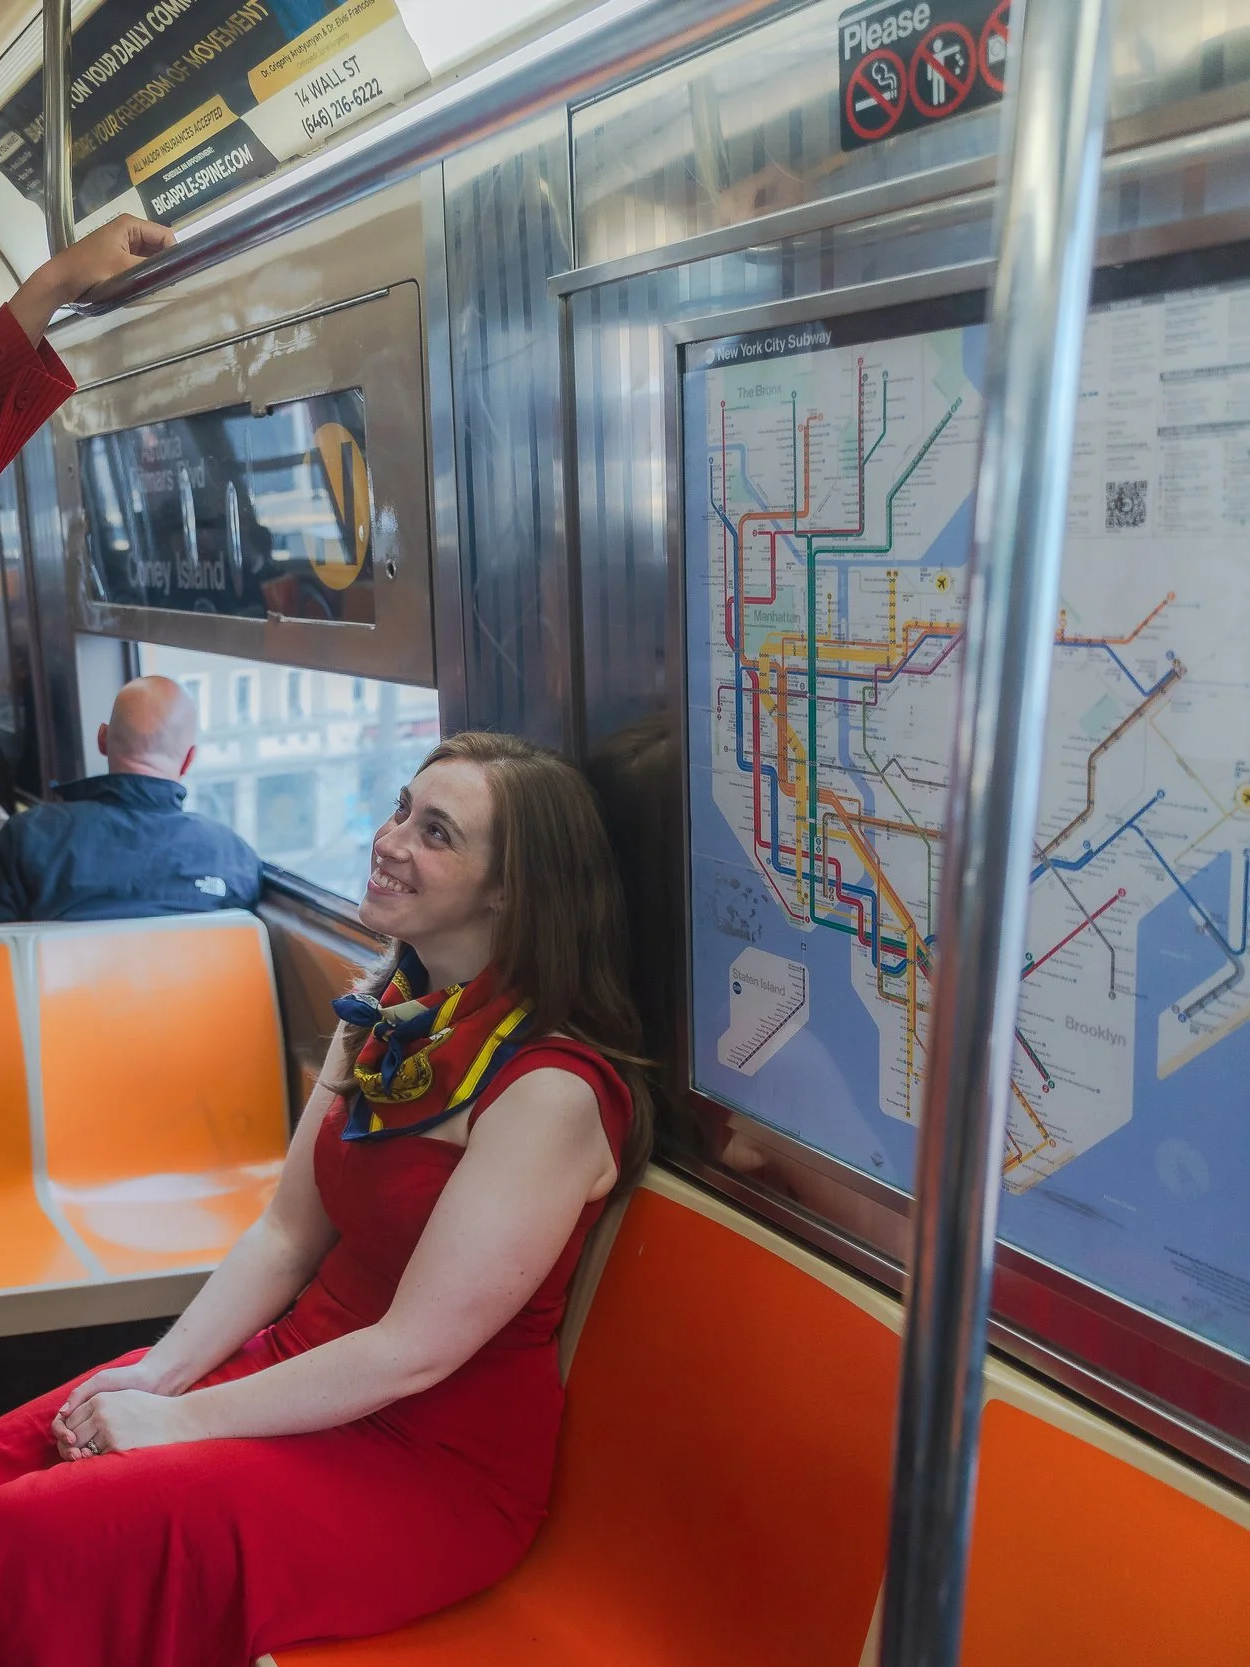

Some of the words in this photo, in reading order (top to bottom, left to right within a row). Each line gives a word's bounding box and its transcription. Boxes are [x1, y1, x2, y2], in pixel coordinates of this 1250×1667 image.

[261, 69, 271, 79] Dr.
[291, 32, 323, 58] Arutyunyan
[326, 22, 336, 34] Dr.
[334, 12, 349, 28] Elvis
[843, 2, 931, 60] Please
[71, 82, 93, 104] ON
[82, 52, 121, 87] YOUR
[111, 20, 154, 65] DAILY
[93, 113, 123, 143] YOUR
[118, 75, 175, 126] FREEDOM
[165, 60, 190, 86] OF
[182, 1, 269, 70] MOVEMENT
[294, 87, 309, 108] 14
[307, 68, 346, 100] WALL
[342, 55, 362, 78] ST
[301, 106, 334, 140] (646)
[330, 77, 384, 120] 216-6222
[133, 161, 144, 175] ALL
[142, 149, 162, 168] MAJOR
[160, 127, 195, 157] INSURANCES
[194, 105, 224, 134] ACCEPTED
[150, 143, 254, 216] BIGAPPLE-SPINE.COM
[717, 346, 739, 362] New
[739, 340, 763, 357] York
[765, 335, 787, 355] City
[788, 329, 832, 349] Subway
[737, 386, 754, 399] The
[755, 384, 782, 397] Bronx
[176, 550, 226, 592] Island
[753, 609, 801, 624] Manhattan
[732, 967, 759, 987] Staten
[760, 977, 786, 996] Island
[1065, 1015, 1127, 1048] Brooklyn
